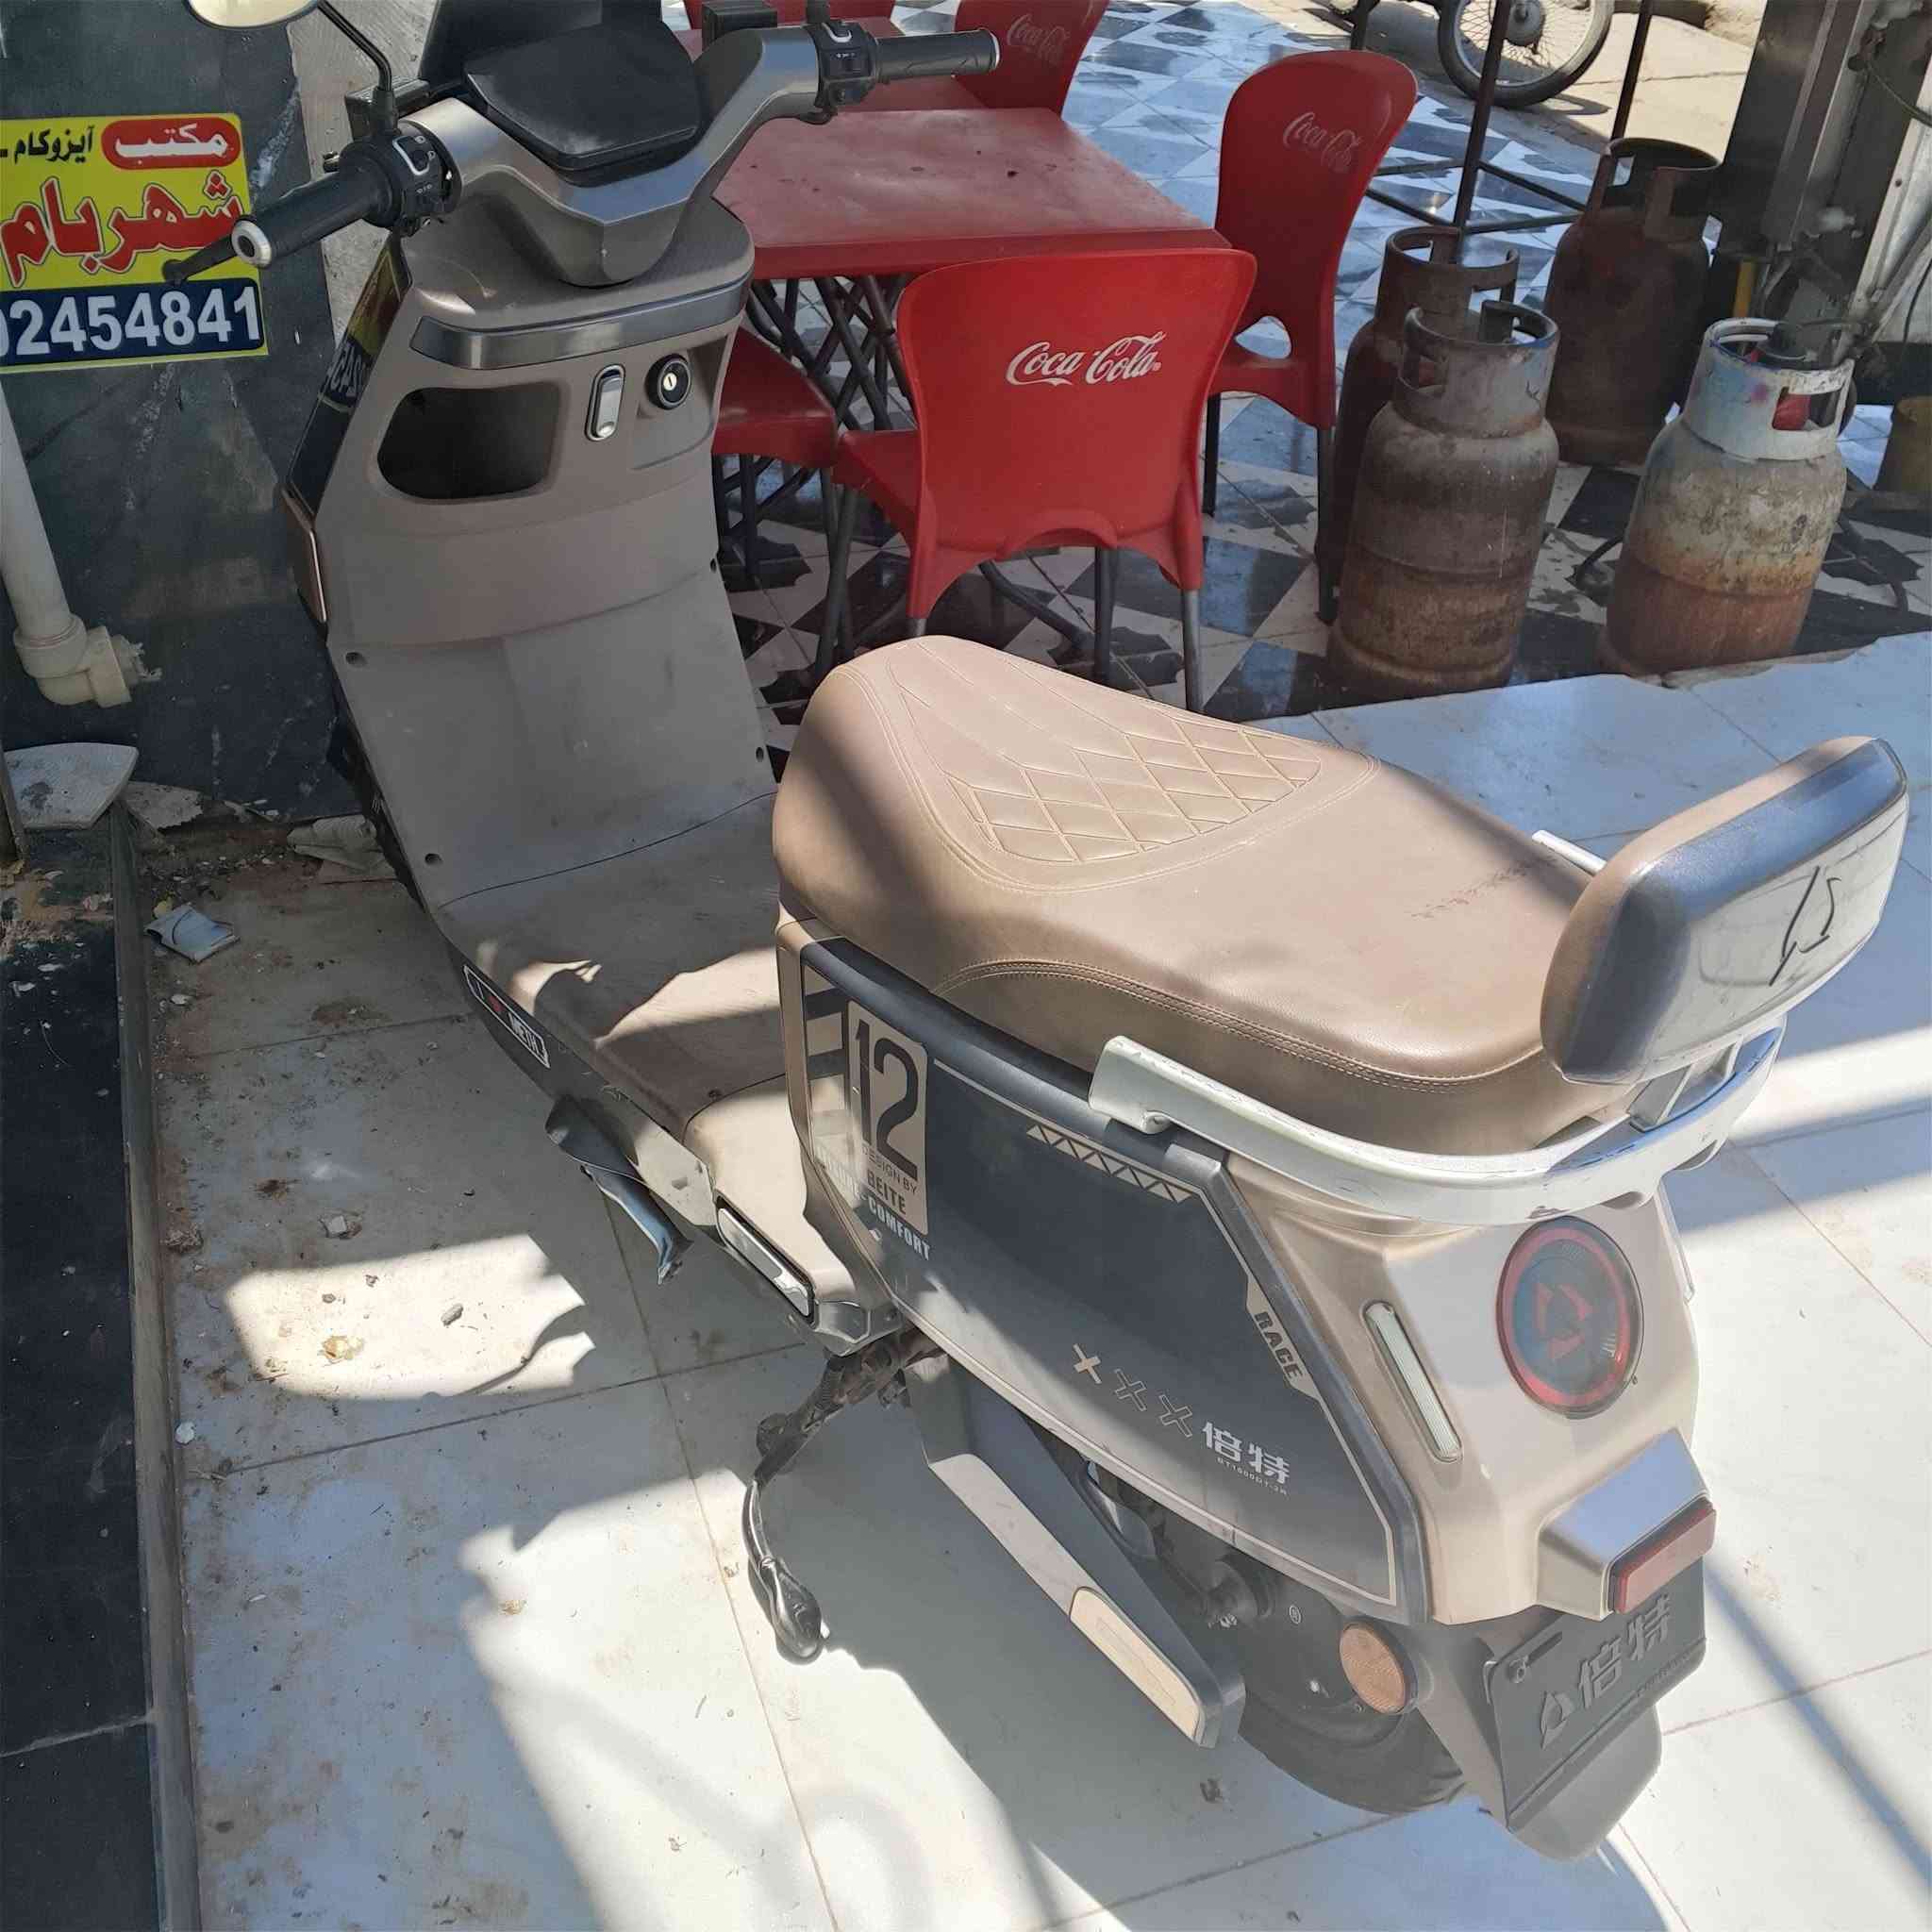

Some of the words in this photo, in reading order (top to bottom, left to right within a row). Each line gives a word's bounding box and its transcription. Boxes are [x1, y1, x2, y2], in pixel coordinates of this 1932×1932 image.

[0, 286, 260, 358] 2454841
[855, 1018, 919, 1182] 12
[867, 1169, 907, 1215] BEITE
[902, 1176, 917, 1195] BY
[1254, 1310, 1304, 1379] RACE
[1201, 1421, 1291, 1485] 倍特
